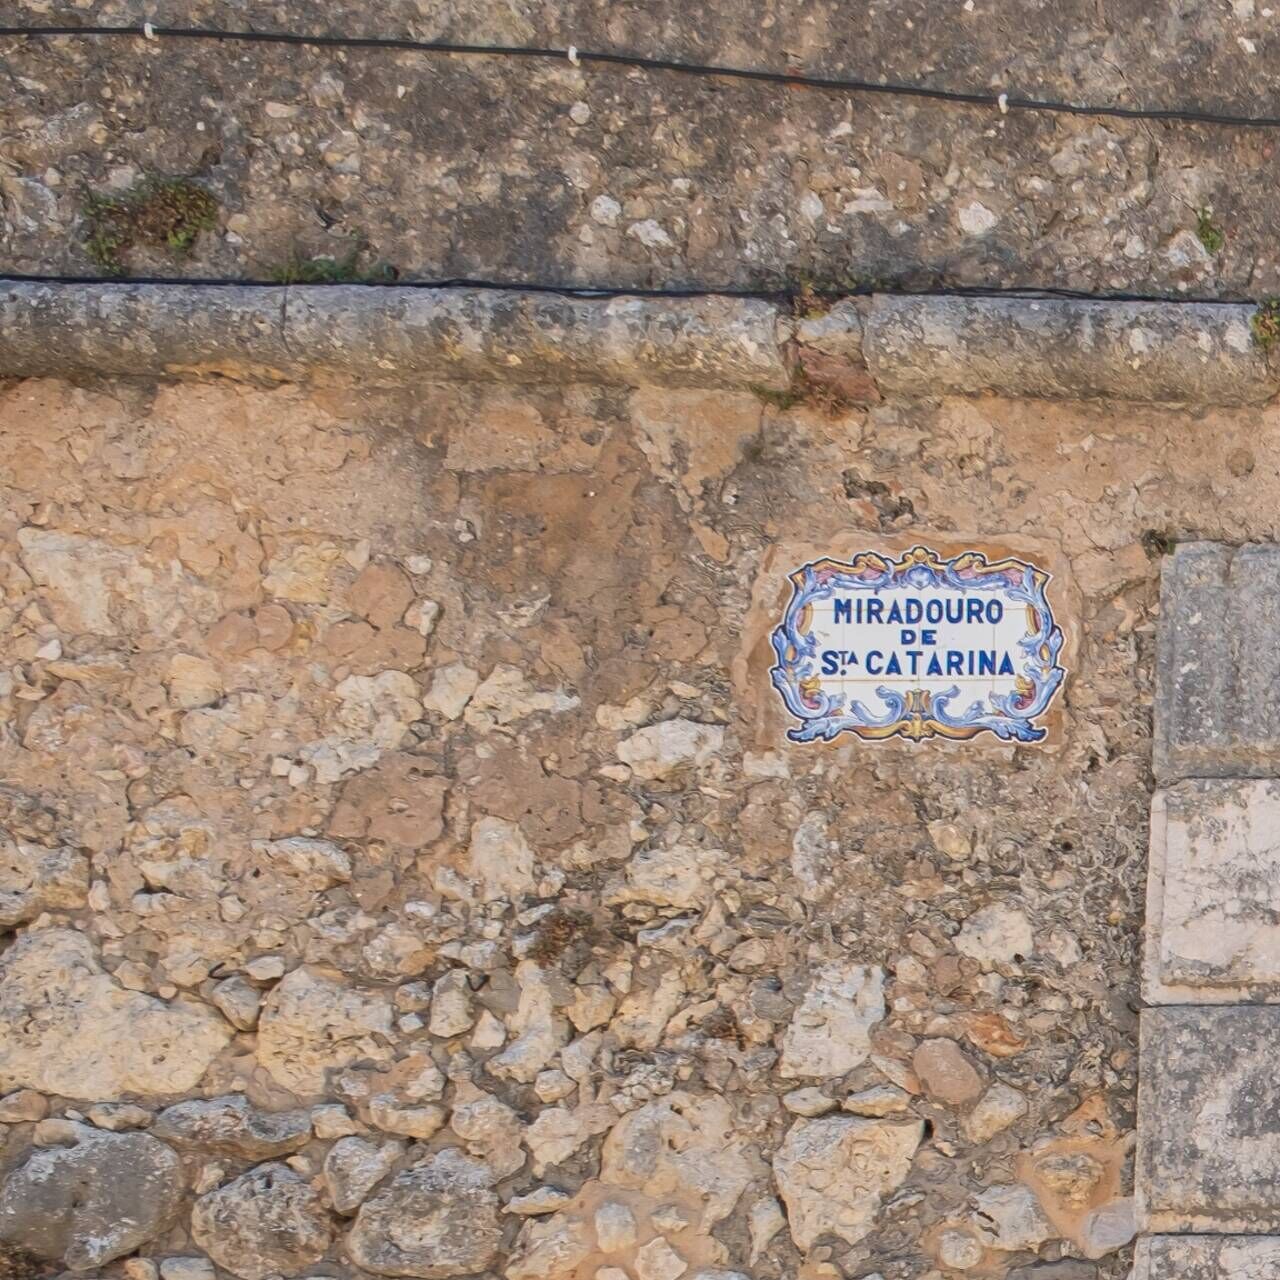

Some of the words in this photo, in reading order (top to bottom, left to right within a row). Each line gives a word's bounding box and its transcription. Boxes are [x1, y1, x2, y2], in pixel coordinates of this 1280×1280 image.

[834, 598, 1003, 624] MIRADOURO
[901, 629, 937, 645] DE
[866, 650, 1015, 675] CATARINA
